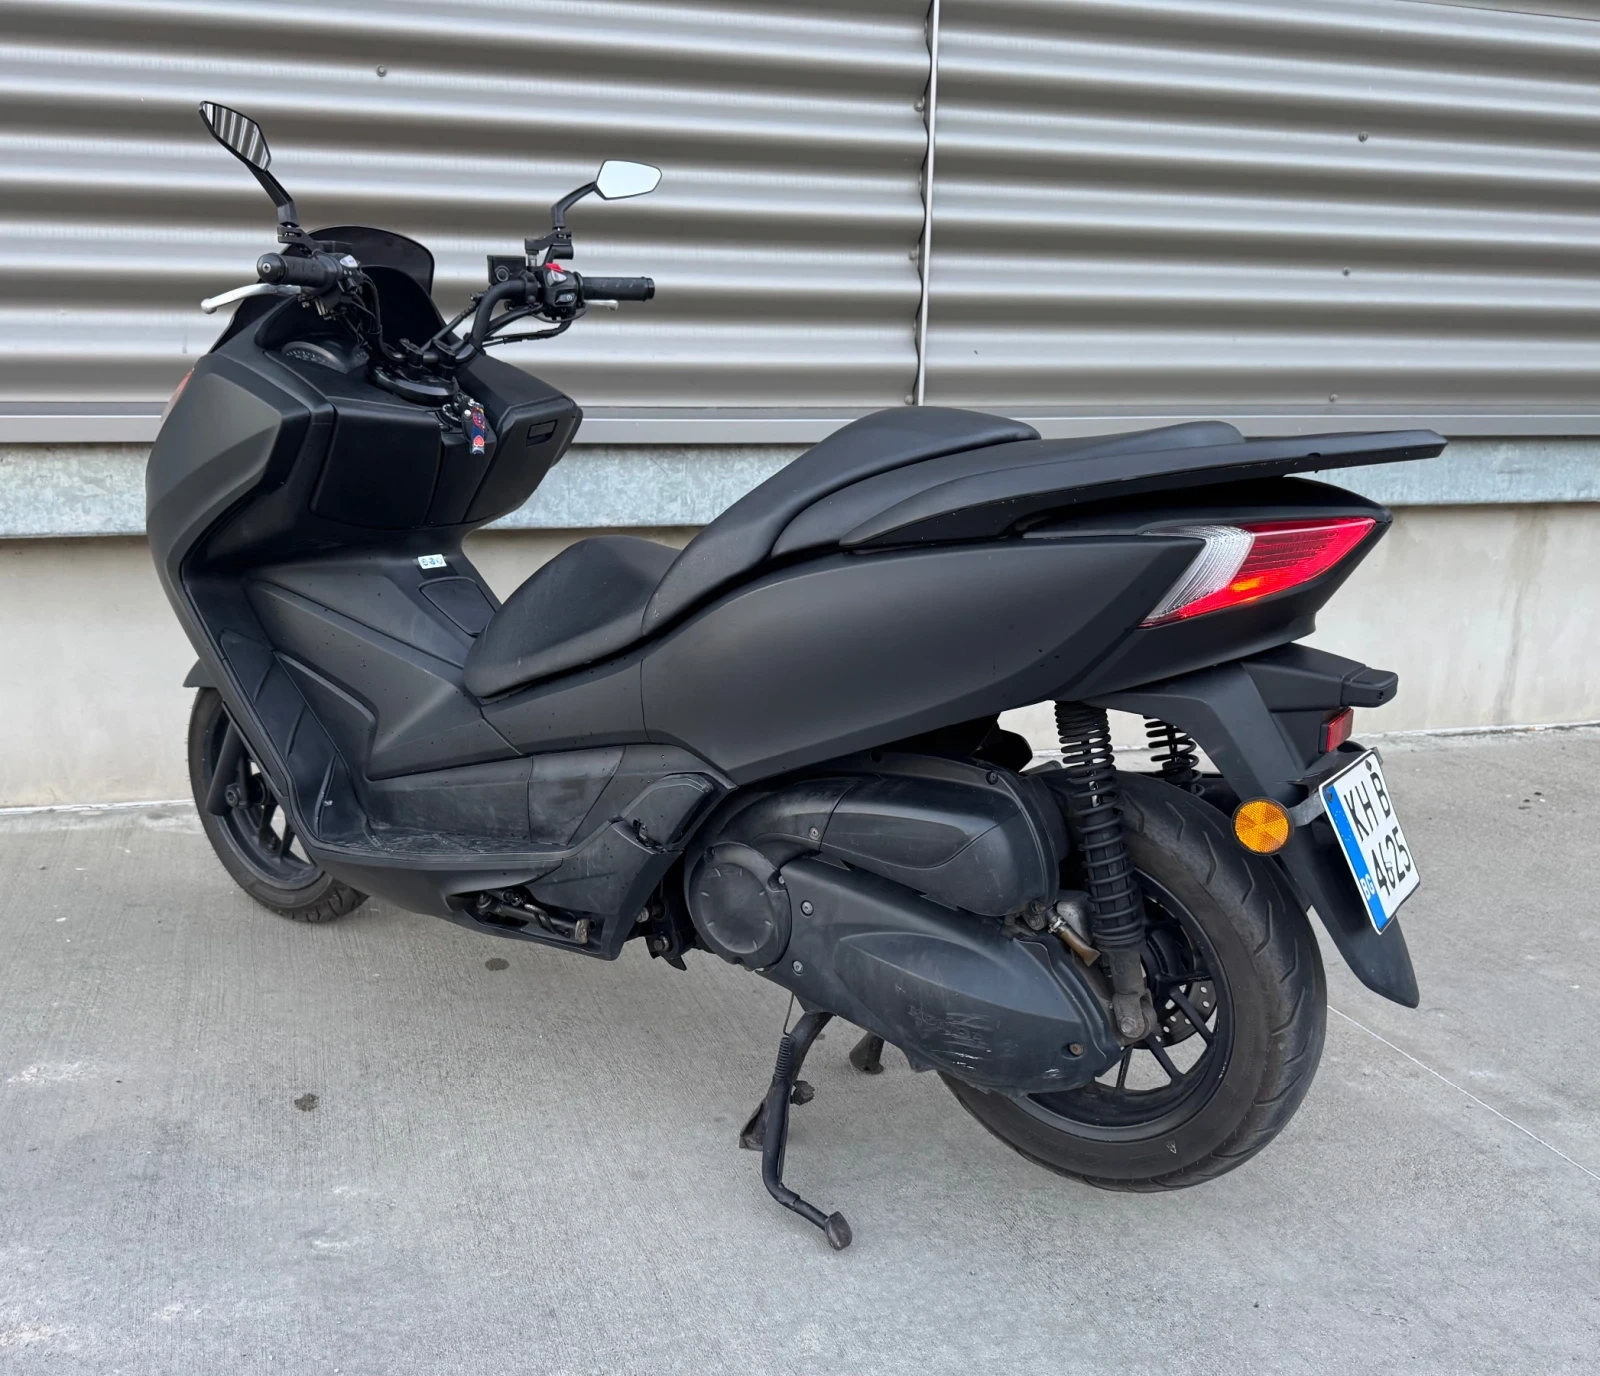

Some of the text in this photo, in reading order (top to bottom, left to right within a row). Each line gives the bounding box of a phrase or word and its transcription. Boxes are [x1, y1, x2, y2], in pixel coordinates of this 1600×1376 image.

[1343, 772, 1391, 842] KH B
[1360, 874, 1376, 901] BG
[1371, 827, 1412, 897] 4625
